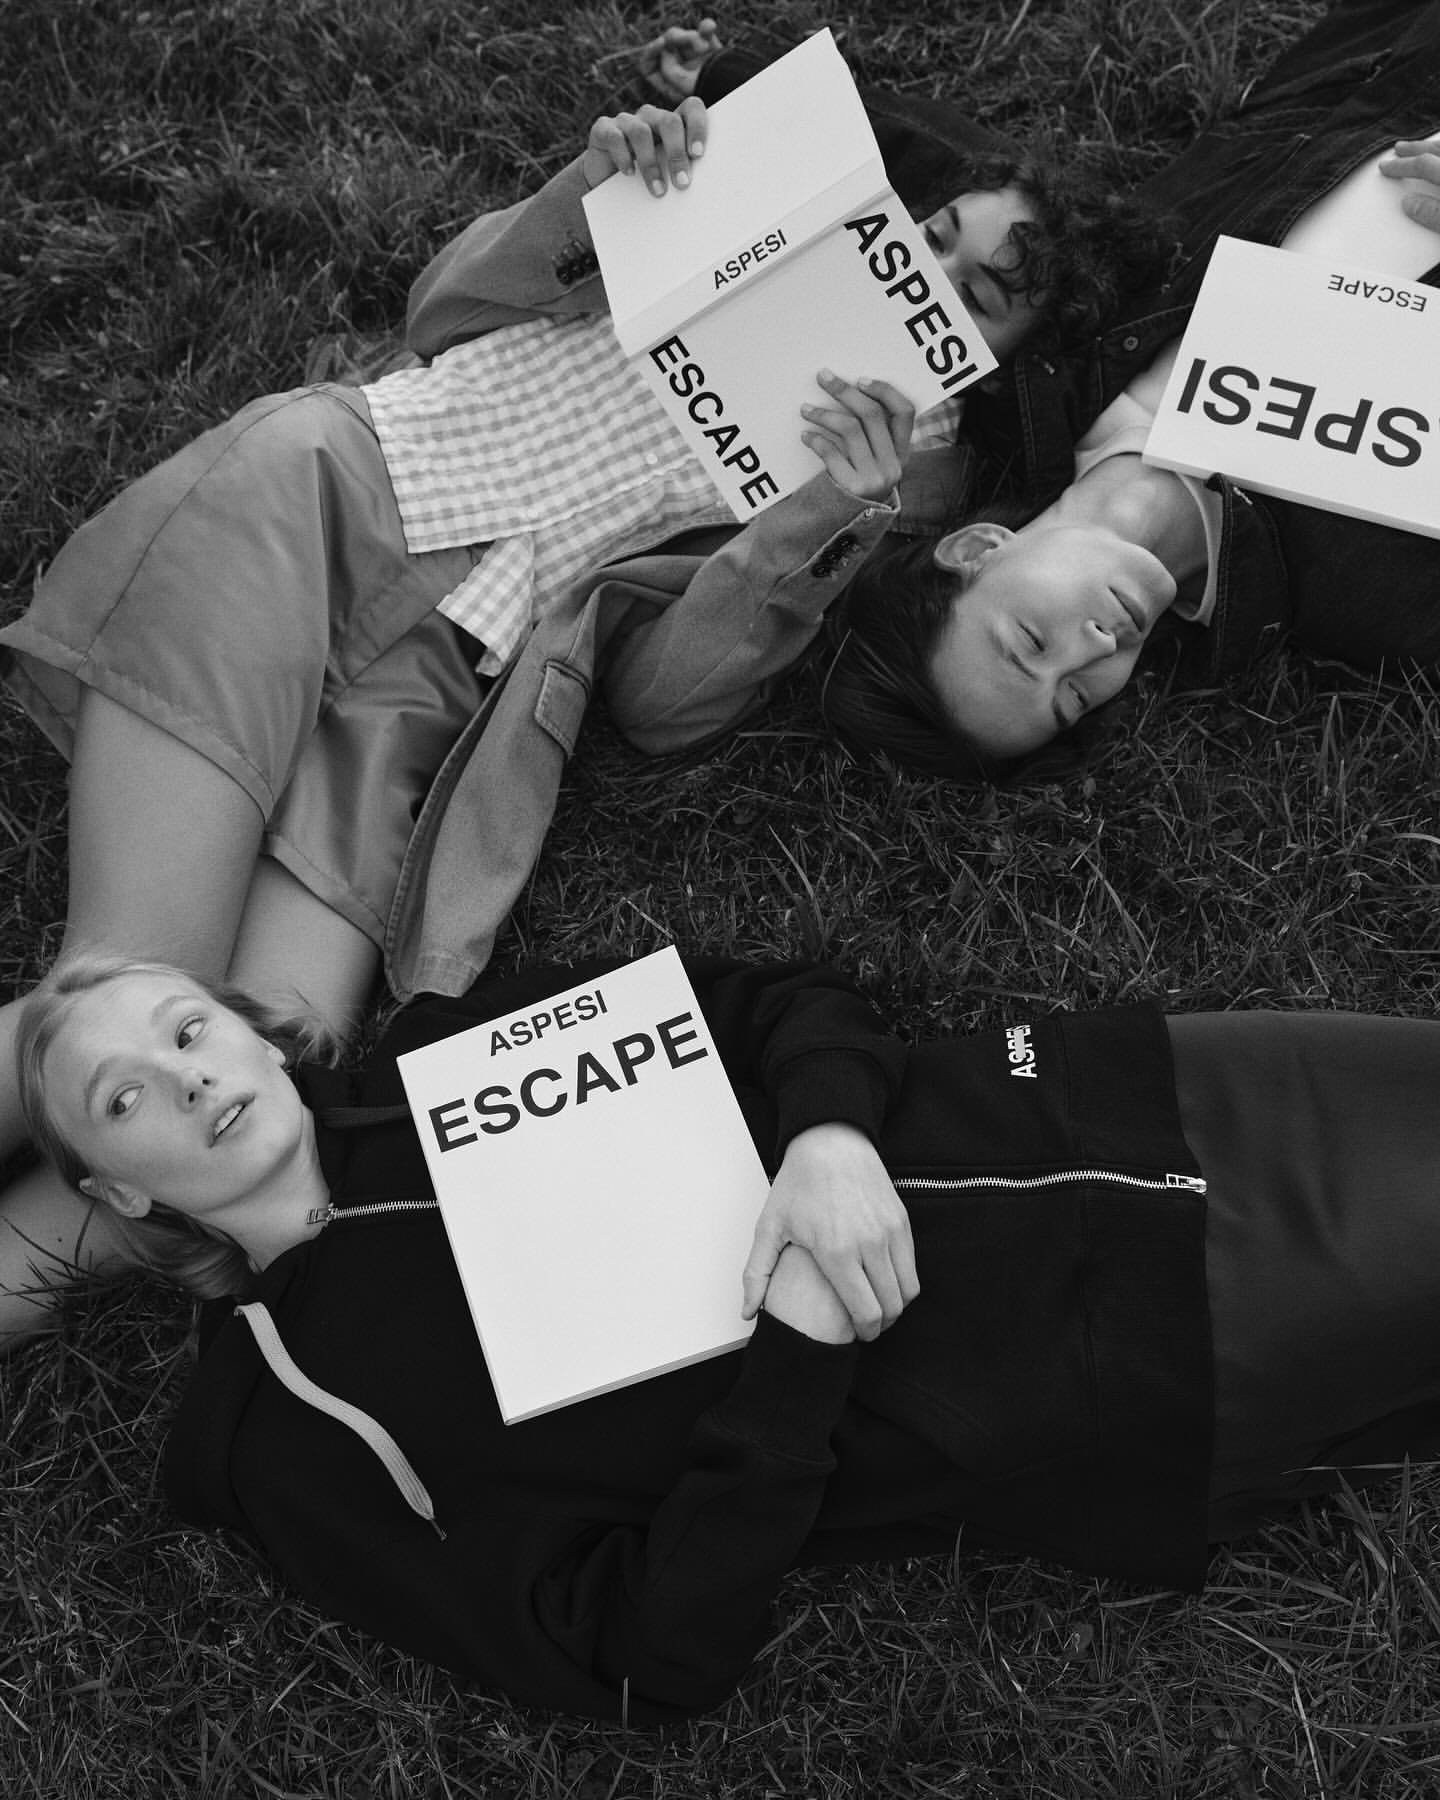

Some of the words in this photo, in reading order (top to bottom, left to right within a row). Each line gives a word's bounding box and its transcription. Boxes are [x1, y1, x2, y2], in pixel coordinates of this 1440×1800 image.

[713, 229, 787, 289] ASPESI
[844, 213, 978, 390] ASPESI
[1327, 274, 1427, 312] ESCAPE
[649, 335, 779, 508] ESCAPE
[1177, 358, 1440, 467] SPESI
[489, 990, 608, 1056] ASPESI
[428, 1012, 709, 1153] ESCAPE
